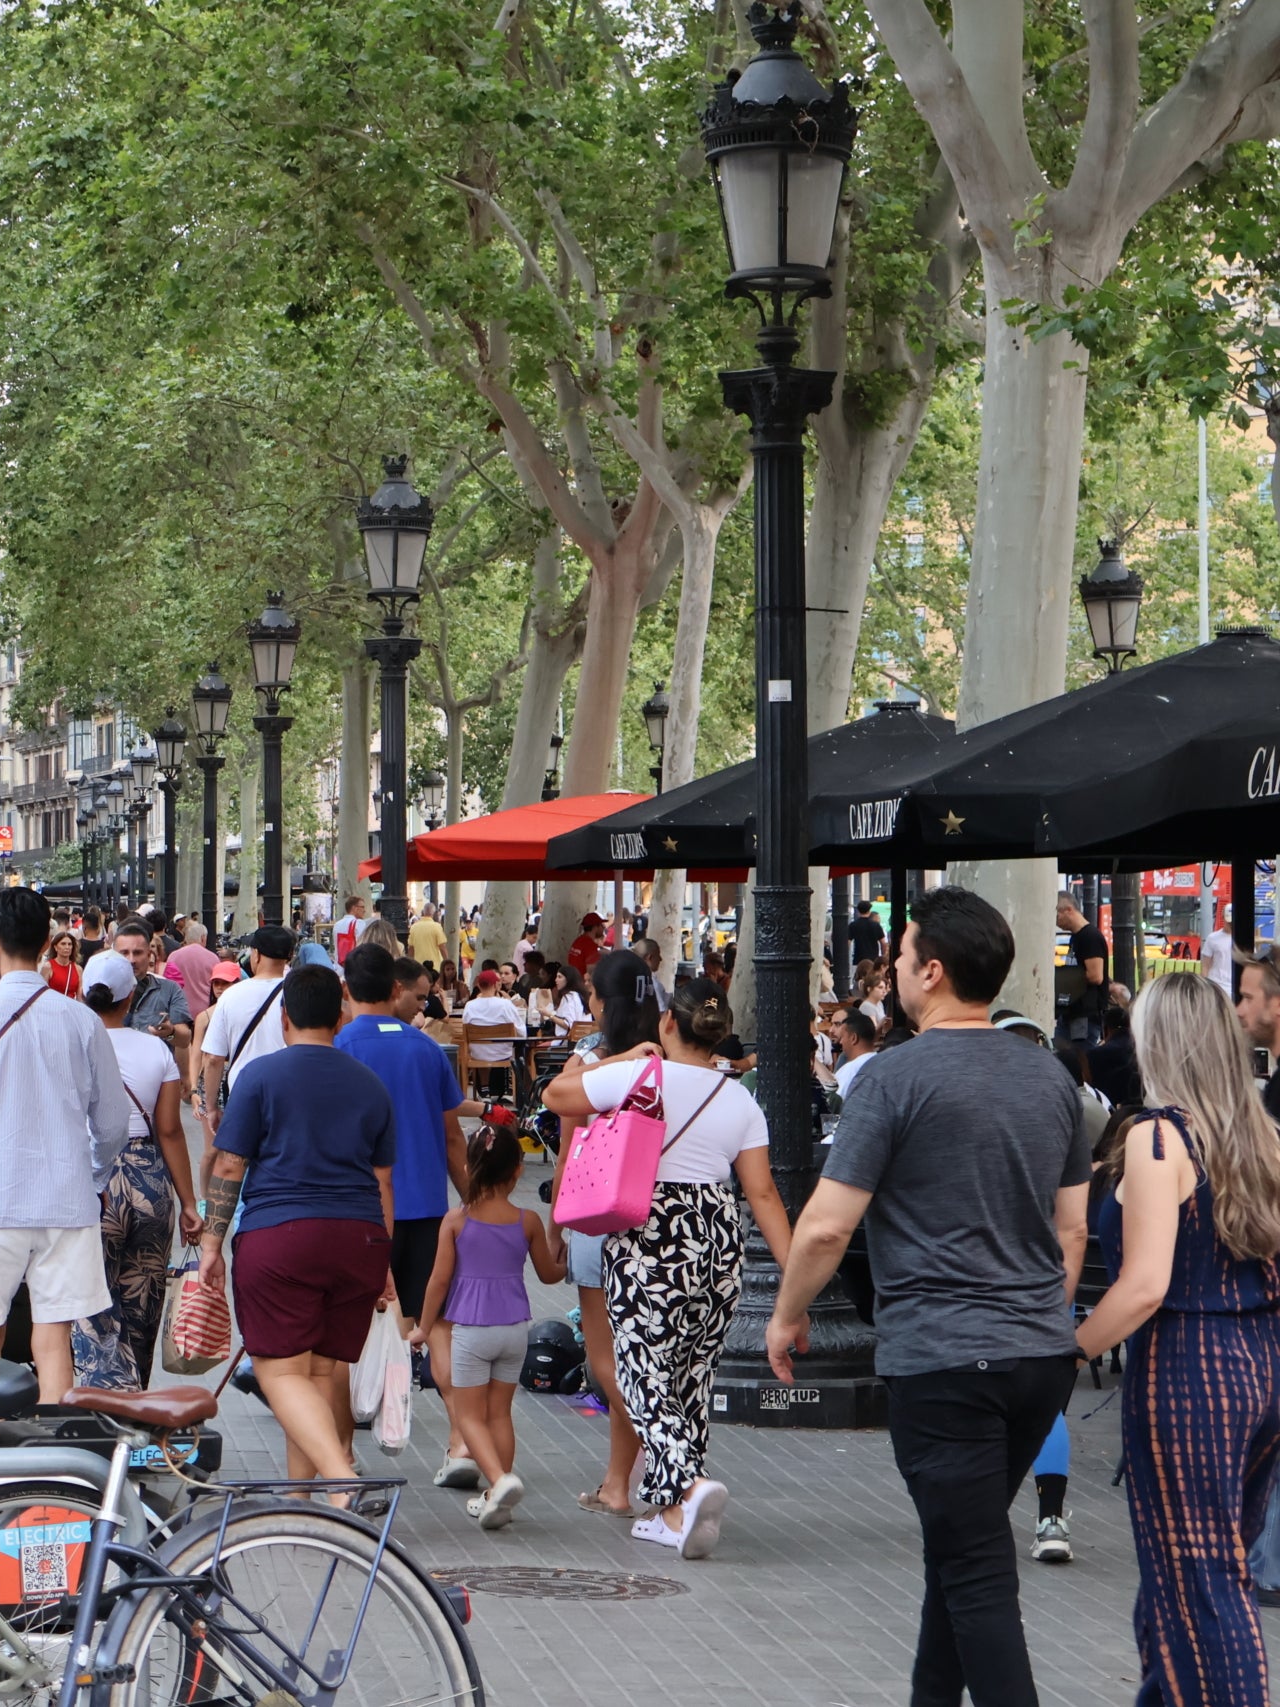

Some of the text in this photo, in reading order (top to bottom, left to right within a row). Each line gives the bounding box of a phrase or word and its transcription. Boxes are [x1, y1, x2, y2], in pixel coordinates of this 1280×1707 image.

[849, 802, 874, 840] CAFE
[610, 833, 629, 860] CAFE
[760, 1388, 789, 1403] DERO
[791, 1389, 819, 1402] 1UP
[4, 1524, 84, 1546] ELECTRIC
[26, 1593, 55, 1601] DOWNOAD
